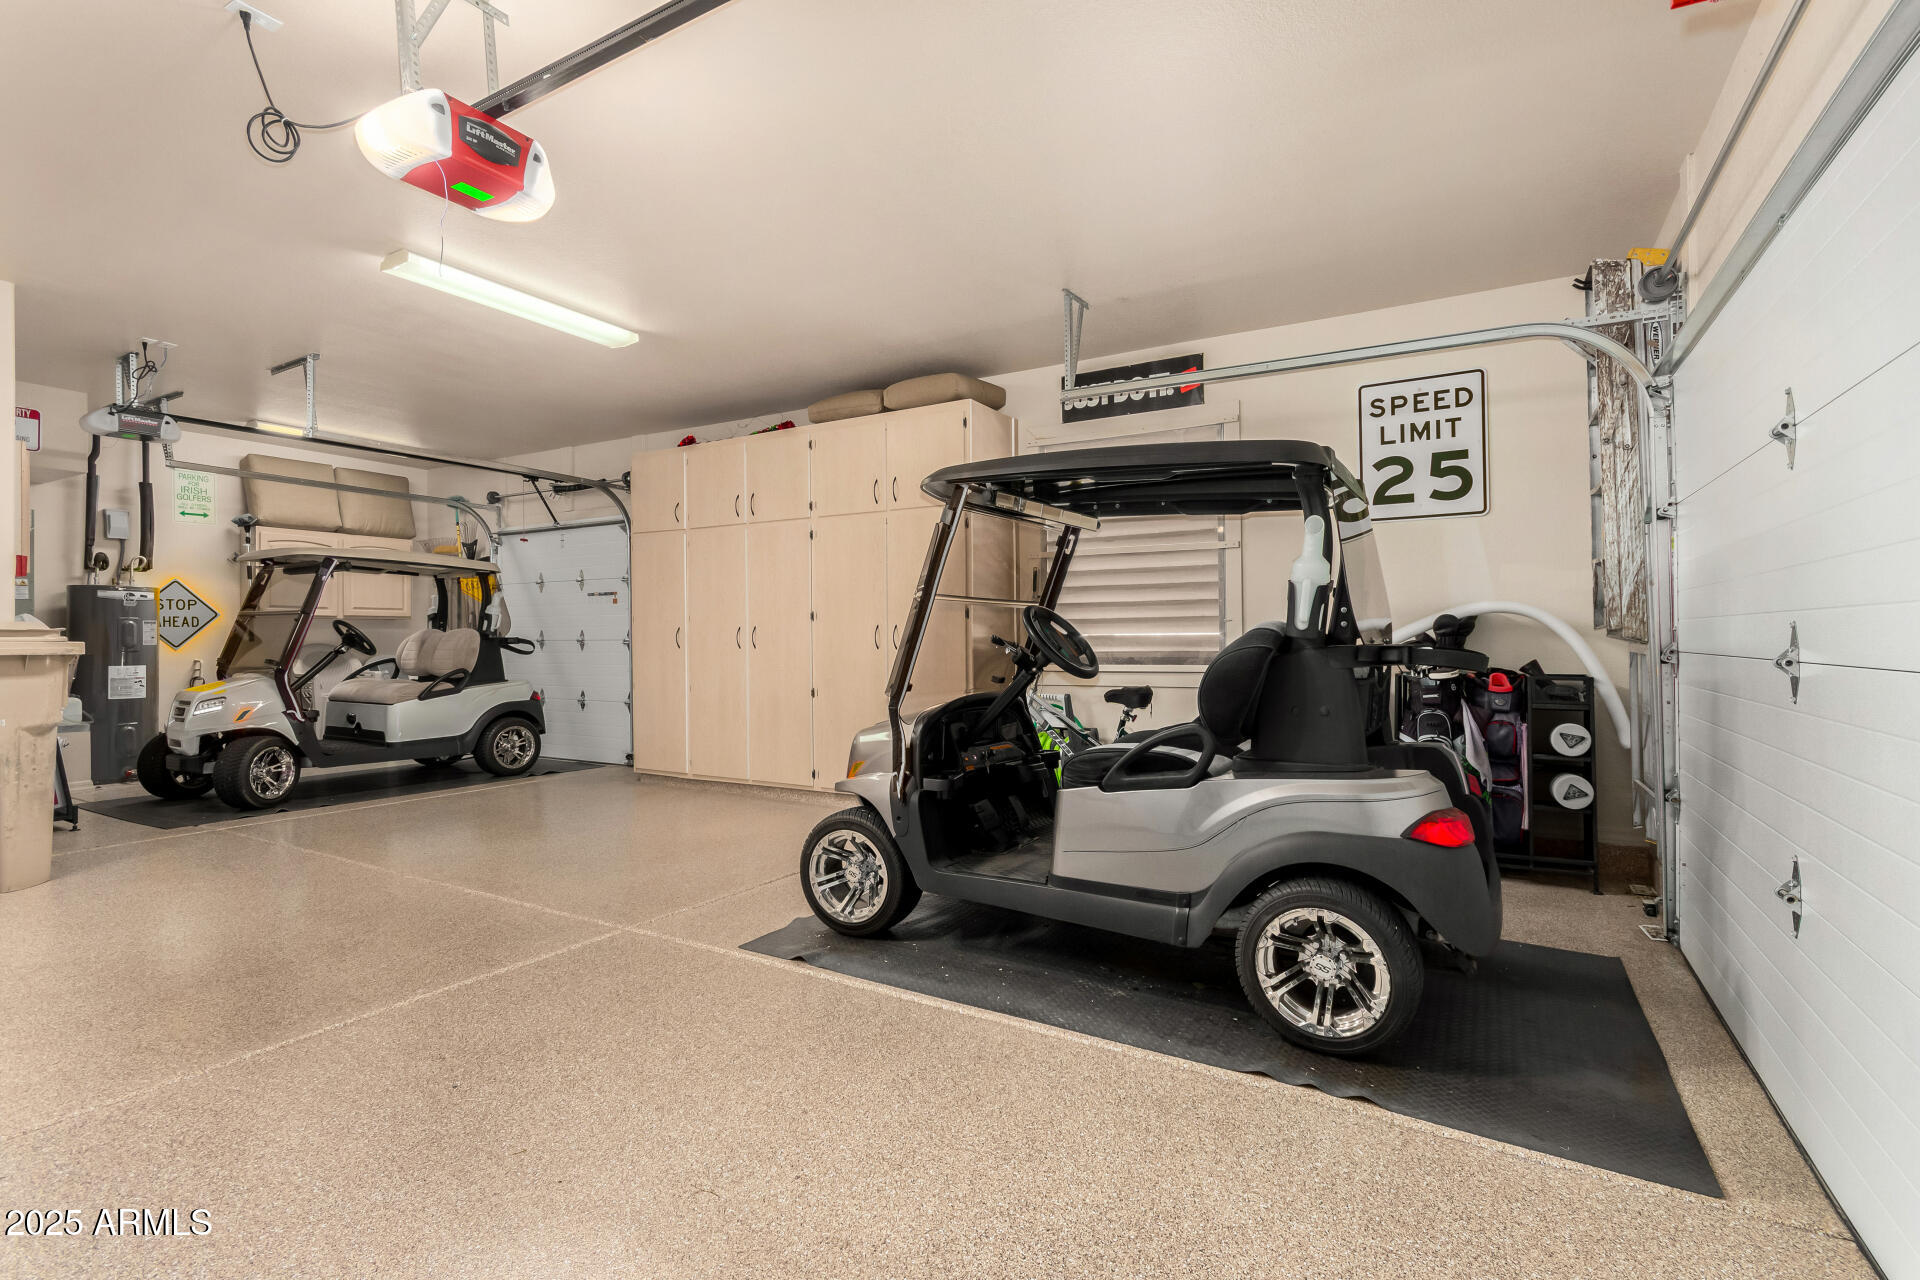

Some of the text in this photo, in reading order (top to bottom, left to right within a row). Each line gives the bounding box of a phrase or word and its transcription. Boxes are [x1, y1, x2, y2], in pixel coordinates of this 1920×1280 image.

[1369, 387, 1474, 418] SPEED
[1380, 417, 1462, 445] LIMIT
[178, 472, 209, 483] PARKING
[1372, 449, 1474, 505] 25
[180, 485, 208, 496] IRISH
[176, 493, 212, 503] GOLFERS
[159, 598, 197, 611] STOP
[159, 615, 200, 628] HEAD
